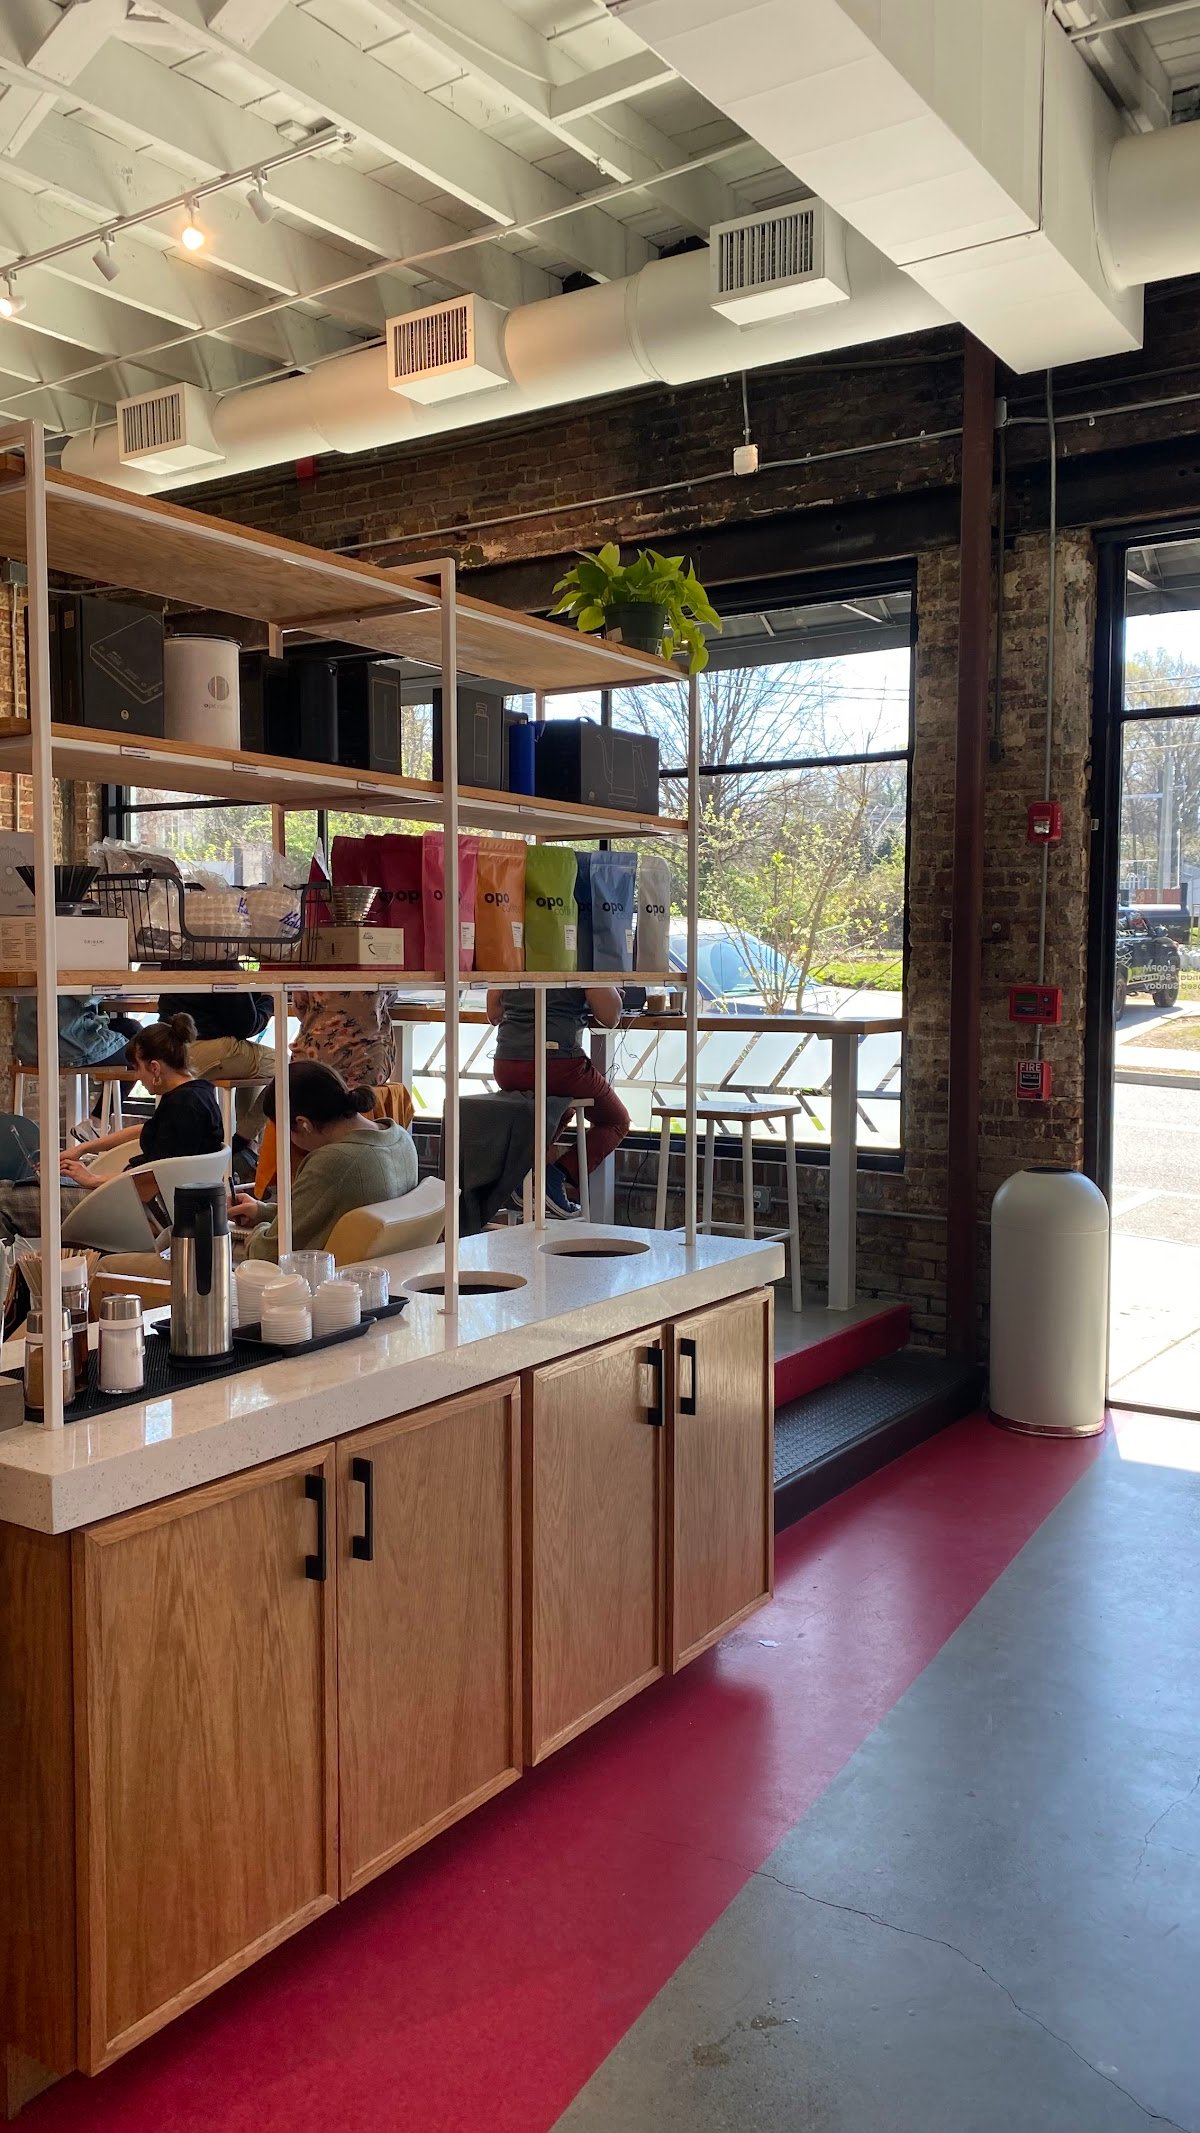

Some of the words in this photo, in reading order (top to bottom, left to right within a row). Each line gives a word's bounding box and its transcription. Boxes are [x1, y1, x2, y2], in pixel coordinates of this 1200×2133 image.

[395, 889, 420, 904] op
[484, 892, 510, 907] opo
[536, 897, 564, 910] opo
[602, 902, 625, 915] opo
[645, 904, 665, 916] opo
[1020, 1062, 1042, 1072] FIRE
